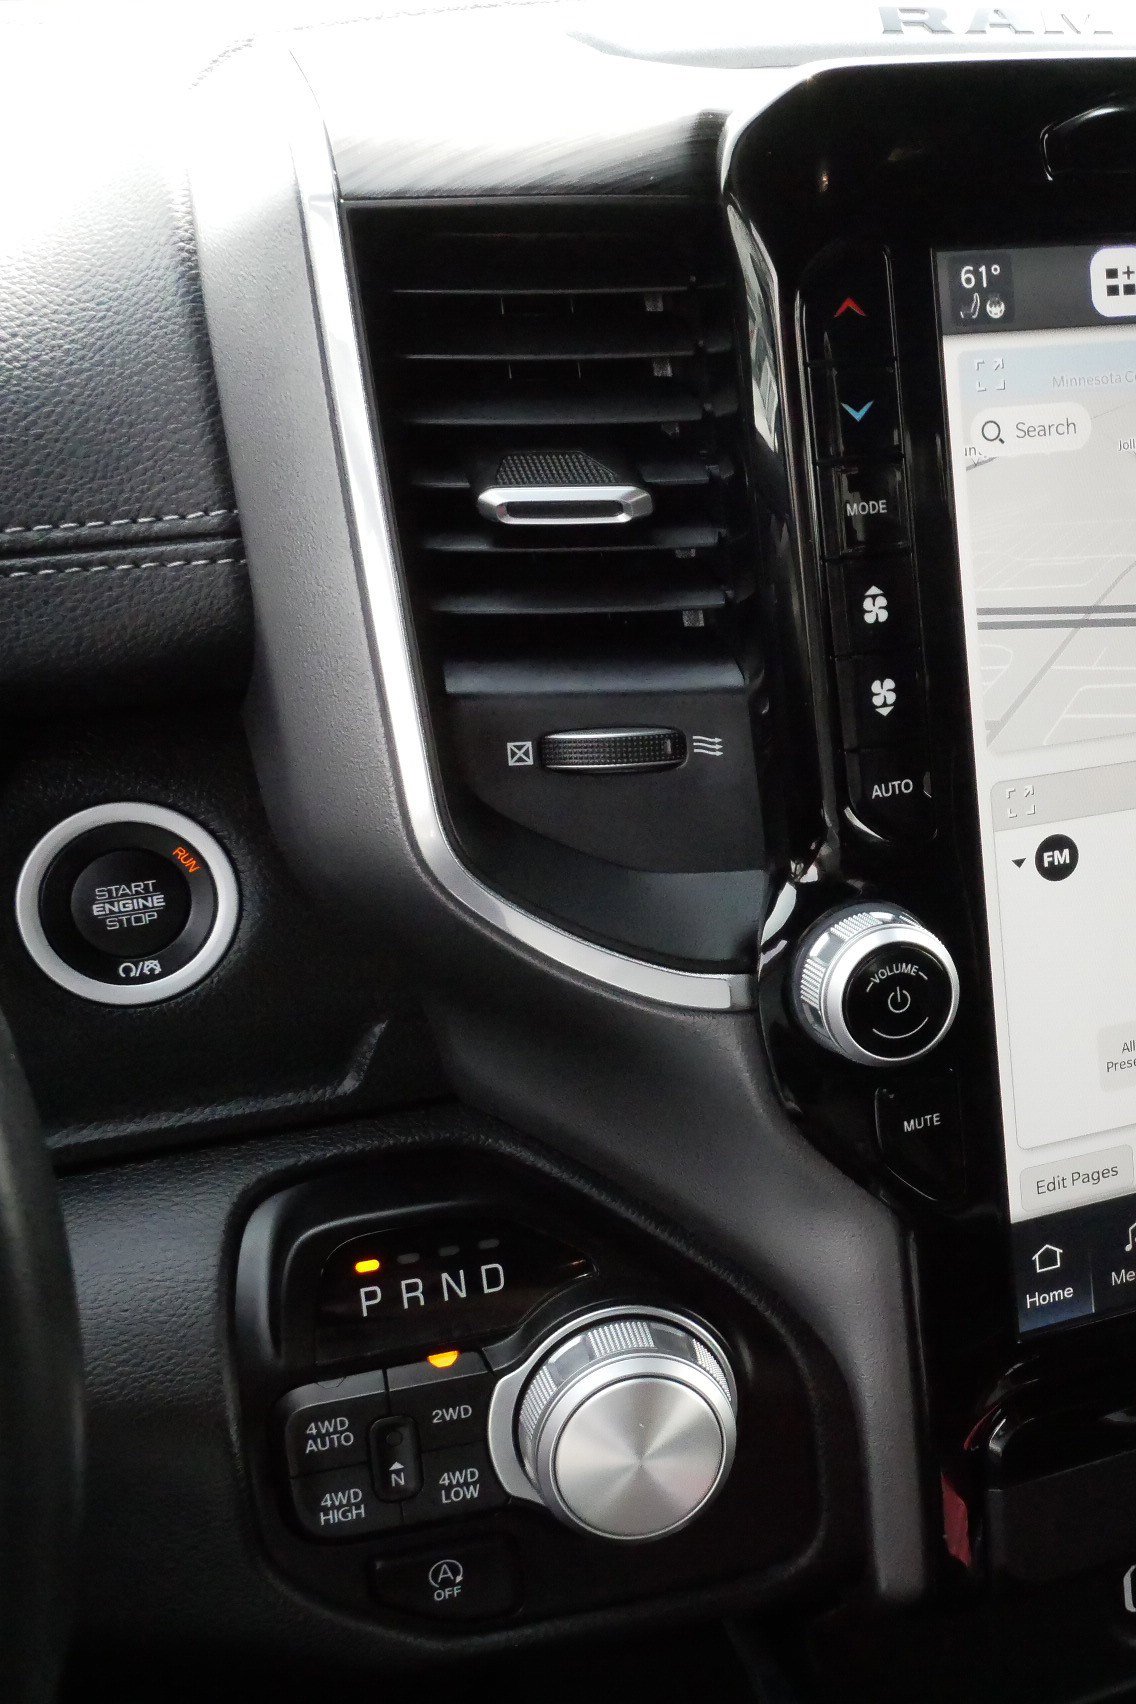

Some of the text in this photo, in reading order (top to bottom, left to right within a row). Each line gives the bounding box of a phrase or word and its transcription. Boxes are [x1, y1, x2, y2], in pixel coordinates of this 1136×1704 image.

[878, 7, 1113, 34] RAM
[960, 264, 1001, 289] 61°
[1052, 372, 1122, 389] Minnesota
[1015, 418, 1077, 440] Search
[846, 499, 887, 517] MODE
[872, 778, 913, 800] AUTO
[172, 846, 201, 874] RUN
[1043, 848, 1071, 868] FM
[95, 880, 157, 900] START
[92, 894, 166, 916] ENGINE
[106, 911, 158, 930] STOP
[871, 962, 920, 984] VOLUME
[1122, 1039, 1136, 1054] All
[903, 1113, 942, 1133] MUTE
[1036, 1165, 1119, 1195] Edit Pages
[359, 1263, 505, 1317] P R N D
[1026, 1286, 1074, 1309] Home
[432, 1404, 473, 1424] 2WD
[306, 1416, 349, 1436] 4WD
[305, 1432, 354, 1454] AUTO
[391, 1473, 405, 1487] N
[438, 1467, 480, 1487] 4WD
[320, 1488, 363, 1507] 4WD
[441, 1484, 480, 1504] LOW
[320, 1504, 366, 1526] HIGH
[433, 1586, 462, 1601] OFF
